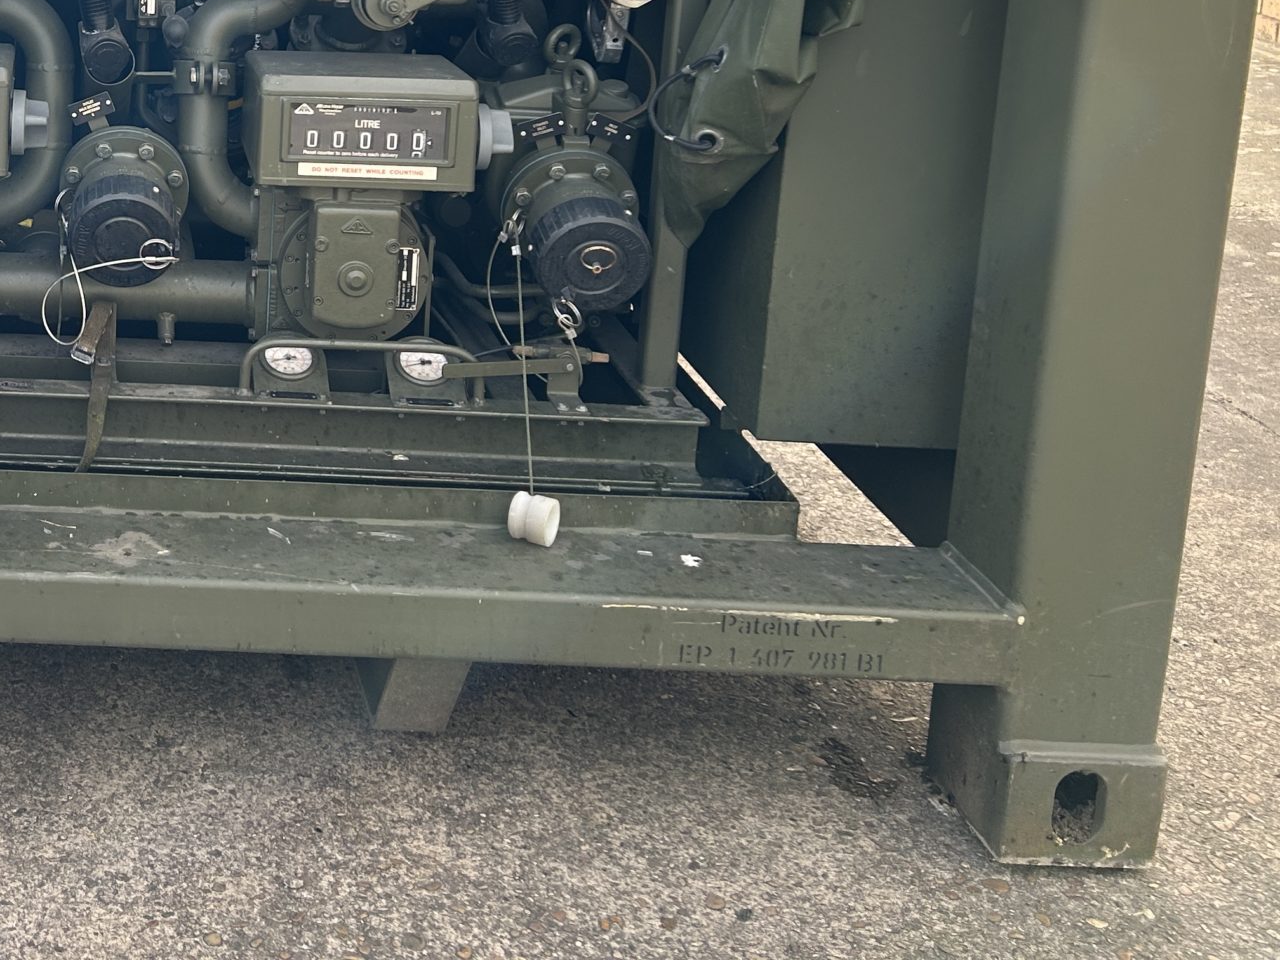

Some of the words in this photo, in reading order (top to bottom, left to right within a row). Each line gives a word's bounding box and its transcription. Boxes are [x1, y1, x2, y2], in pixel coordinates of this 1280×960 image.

[355, 120, 380, 129] LITRE
[307, 130, 318, 147] 0
[333, 131, 344, 148] 0
[360, 132, 371, 149] 0
[387, 133, 398, 150] 0
[413, 133, 423, 151] 0
[722, 615, 800, 636] Patent
[811, 619, 847, 639] Nr.
[680, 644, 712, 664] EP
[729, 647, 735, 665] 1
[752, 649, 794, 668] 407
[808, 651, 846, 671] 981
[858, 653, 883, 673] B1
